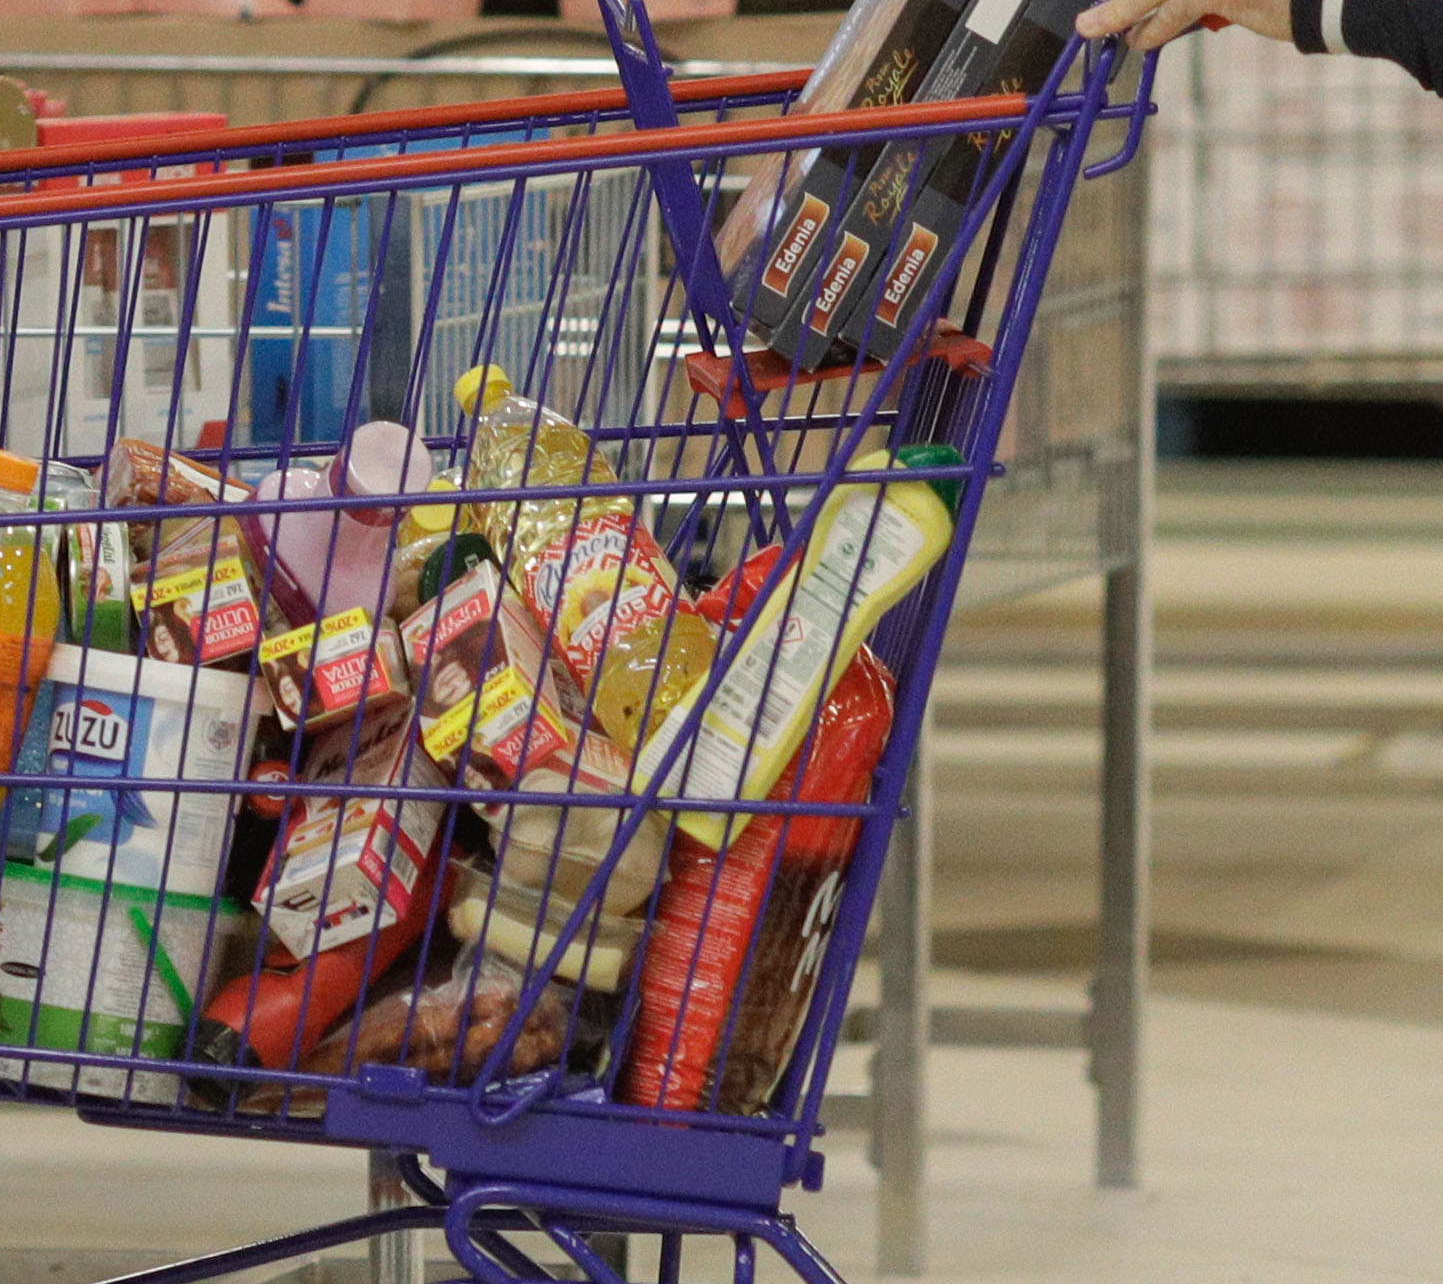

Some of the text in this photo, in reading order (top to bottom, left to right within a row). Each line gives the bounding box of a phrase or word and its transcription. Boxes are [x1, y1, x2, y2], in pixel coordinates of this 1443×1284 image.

[862, 48, 915, 107] Royale
[865, 152, 916, 226] Royale
[775, 218, 816, 273] Edenia
[816, 257, 856, 312] Edenia
[884, 248, 925, 304] Edenia
[197, 606, 251, 633] ULTRA
[54, 711, 120, 750] ZUZU
